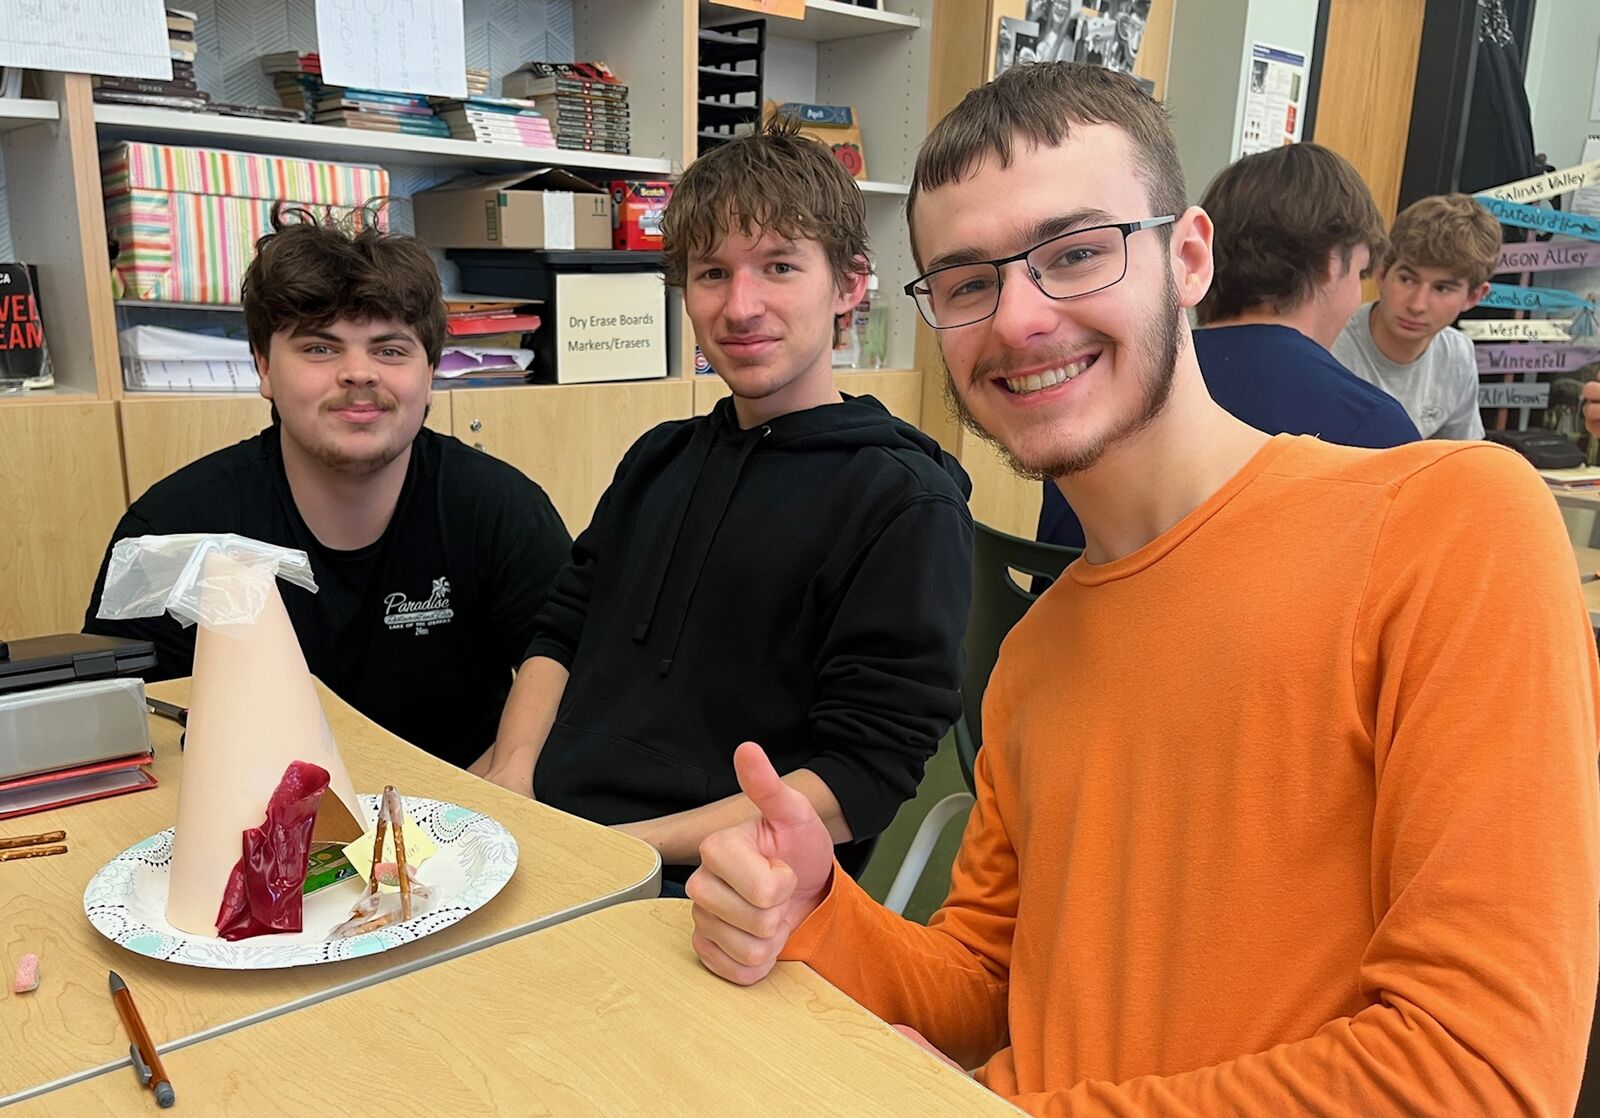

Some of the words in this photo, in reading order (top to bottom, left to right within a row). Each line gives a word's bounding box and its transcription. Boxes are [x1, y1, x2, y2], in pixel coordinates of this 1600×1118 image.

[640, 187, 666, 197] Scotch
[1498, 252, 1539, 268] AGON
[569, 316, 588, 330] Dry
[589, 315, 617, 328] Erase
[619, 313, 655, 327] Boards
[1488, 322, 1519, 337] West
[567, 337, 651, 352] Markers/Erasers
[1488, 350, 1567, 369] Winterfell
[383, 590, 450, 615] Paradise
